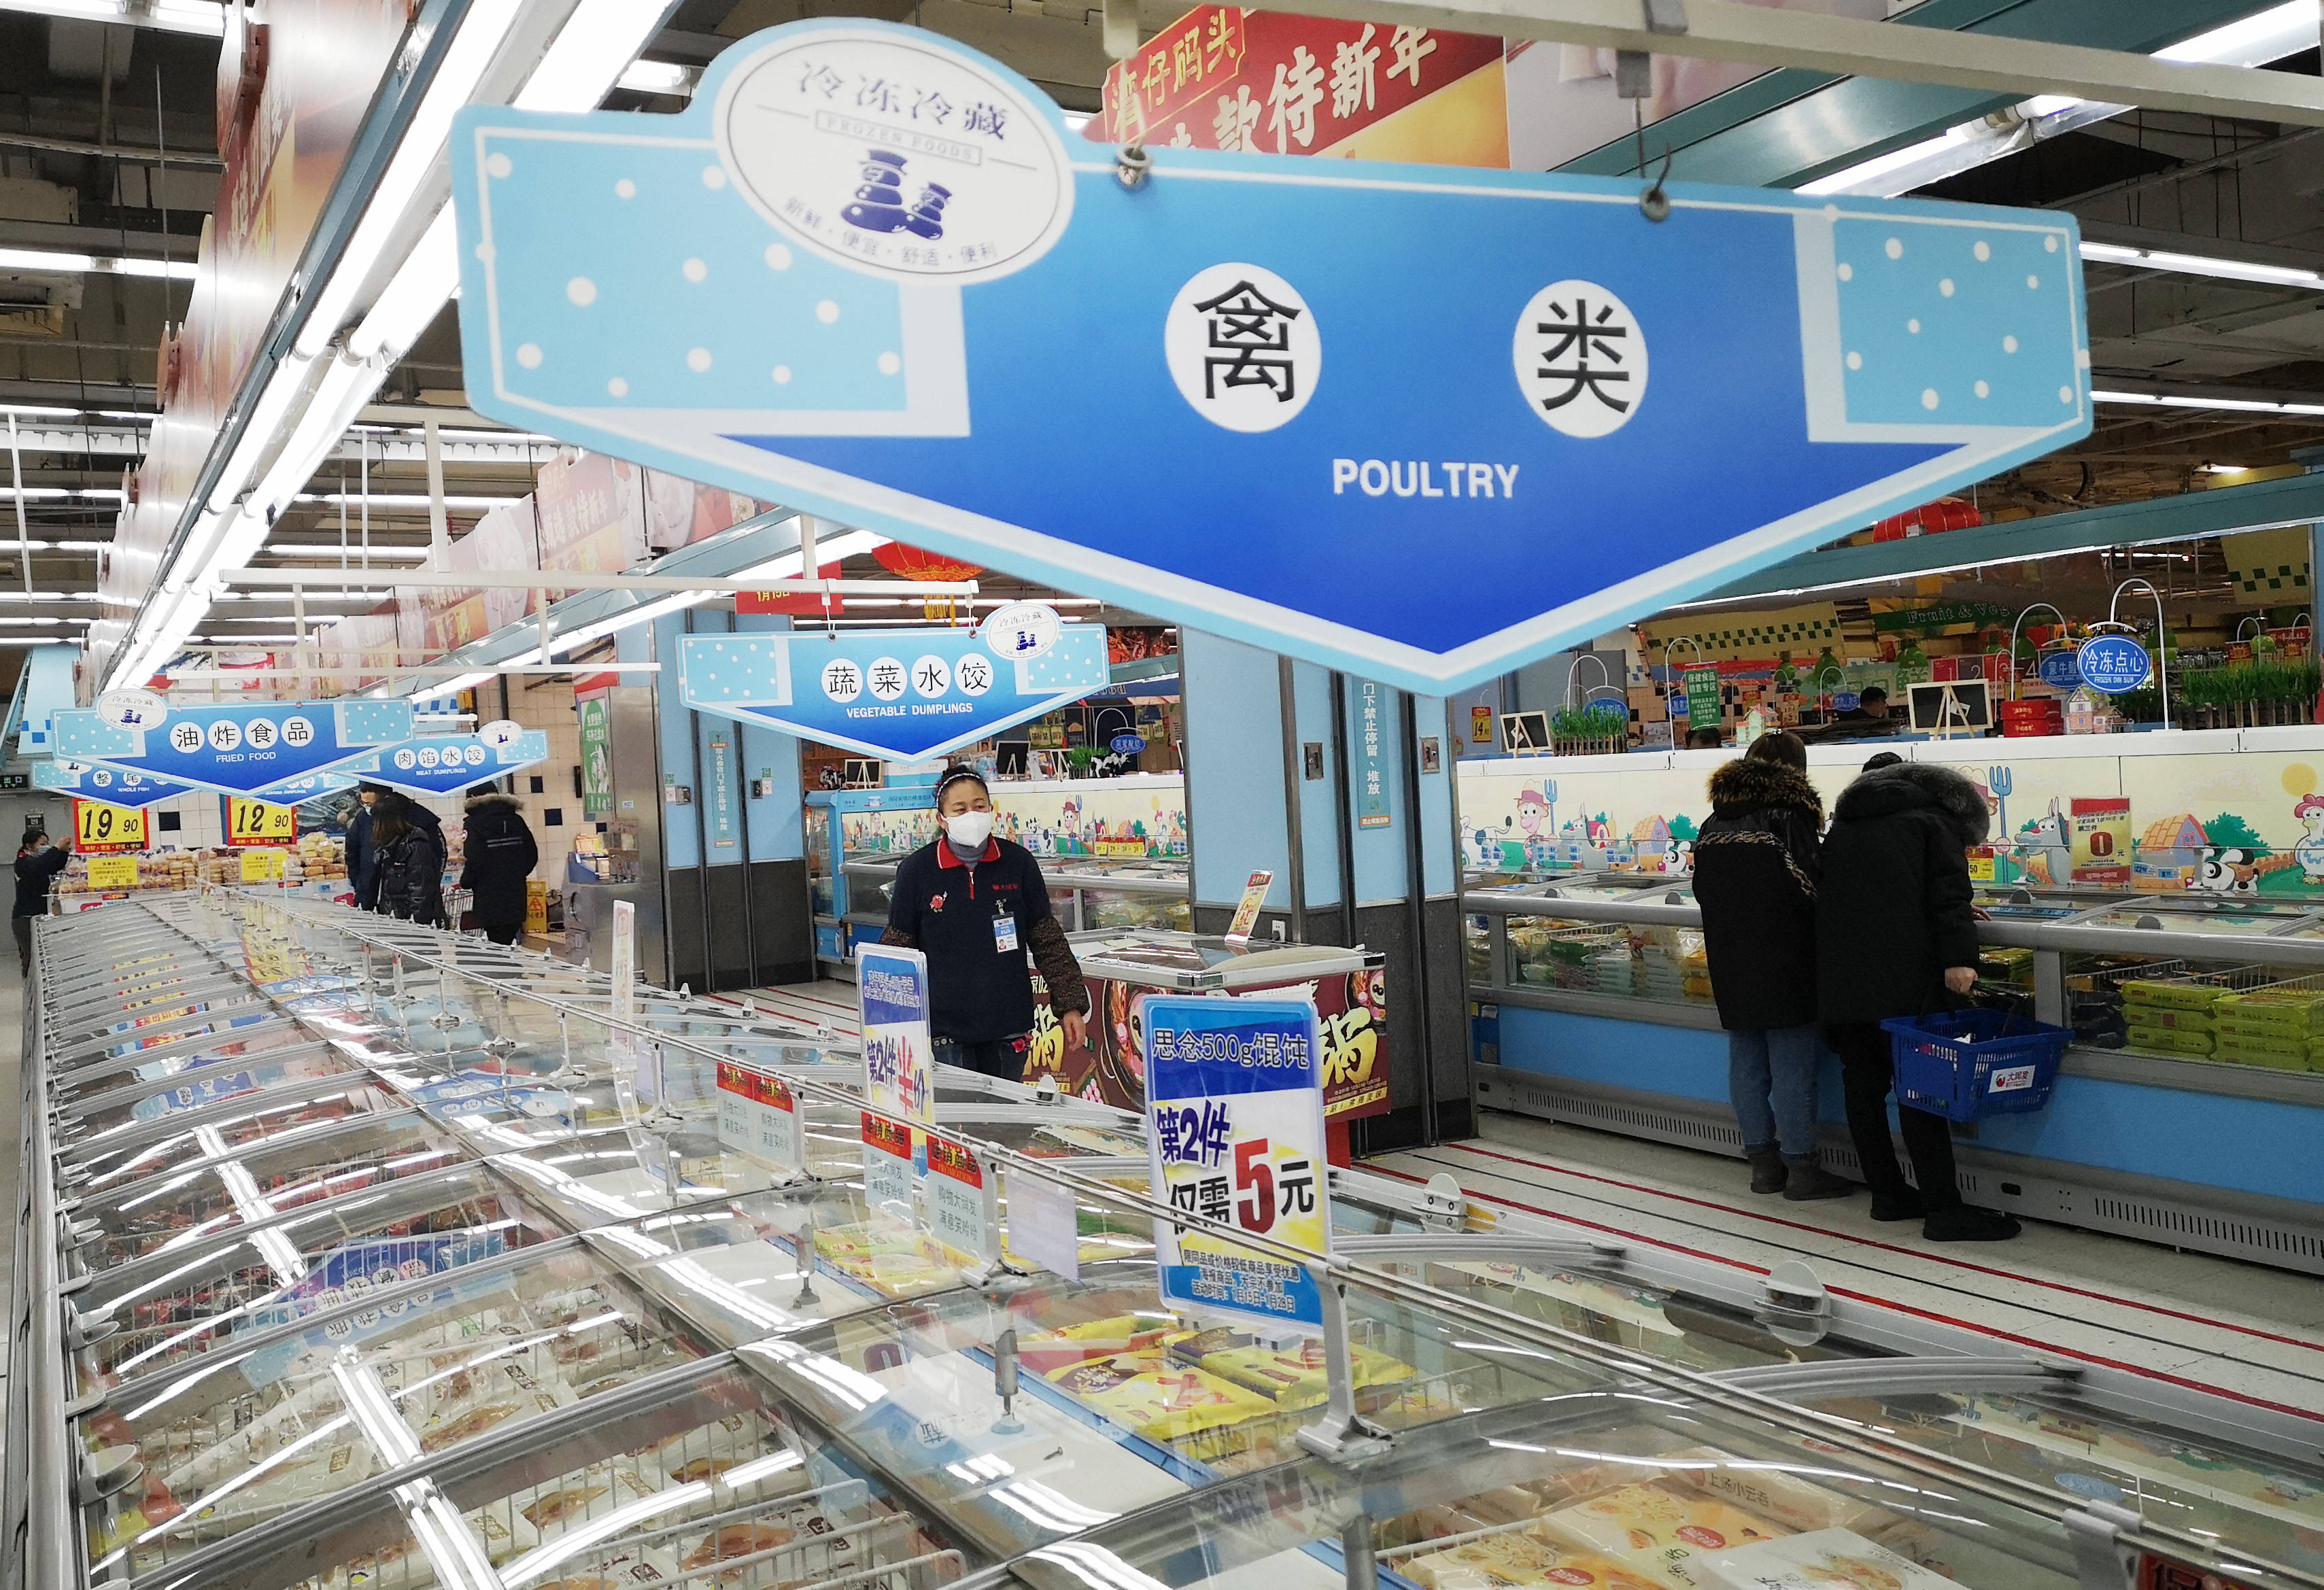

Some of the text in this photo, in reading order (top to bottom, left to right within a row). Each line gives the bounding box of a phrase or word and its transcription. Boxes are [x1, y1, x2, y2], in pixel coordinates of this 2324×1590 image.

[1112, 10, 1237, 134] 湾仔码头
[1161, 22, 1437, 154] 款待新年
[798, 61, 1008, 141] 冷冻冷藏
[827, 118, 974, 160] FROZEN FOODS
[1193, 280, 1630, 413] 禽类
[1333, 458, 1520, 499] POULTRY
[1906, 606, 1953, 624] Fruit
[827, 661, 989, 695] 蔬菜水饺
[1688, 672, 1715, 683] 保健食品
[2085, 649, 2143, 673] 冷冻点心
[1093, 684, 1127, 696] ood
[846, 702, 973, 719] VEGETABLE DUMPLINGS
[176, 722, 309, 747] 油炸食品
[1363, 680, 1381, 795] 门下禁止停留、堆放
[216, 752, 276, 763] FRIED FOOD
[398, 749, 483, 767] 肉馅水饺
[1152, 1027, 1310, 1070] 思念500g馄饨
[867, 1035, 929, 1117] 第2件 半价
[1157, 1100, 1231, 1168] 第2件
[938, 1163, 974, 1183] PROMOTION
[1169, 1138, 1314, 1236] 仅需5元
[938, 1184, 977, 1217] 购物大润发
